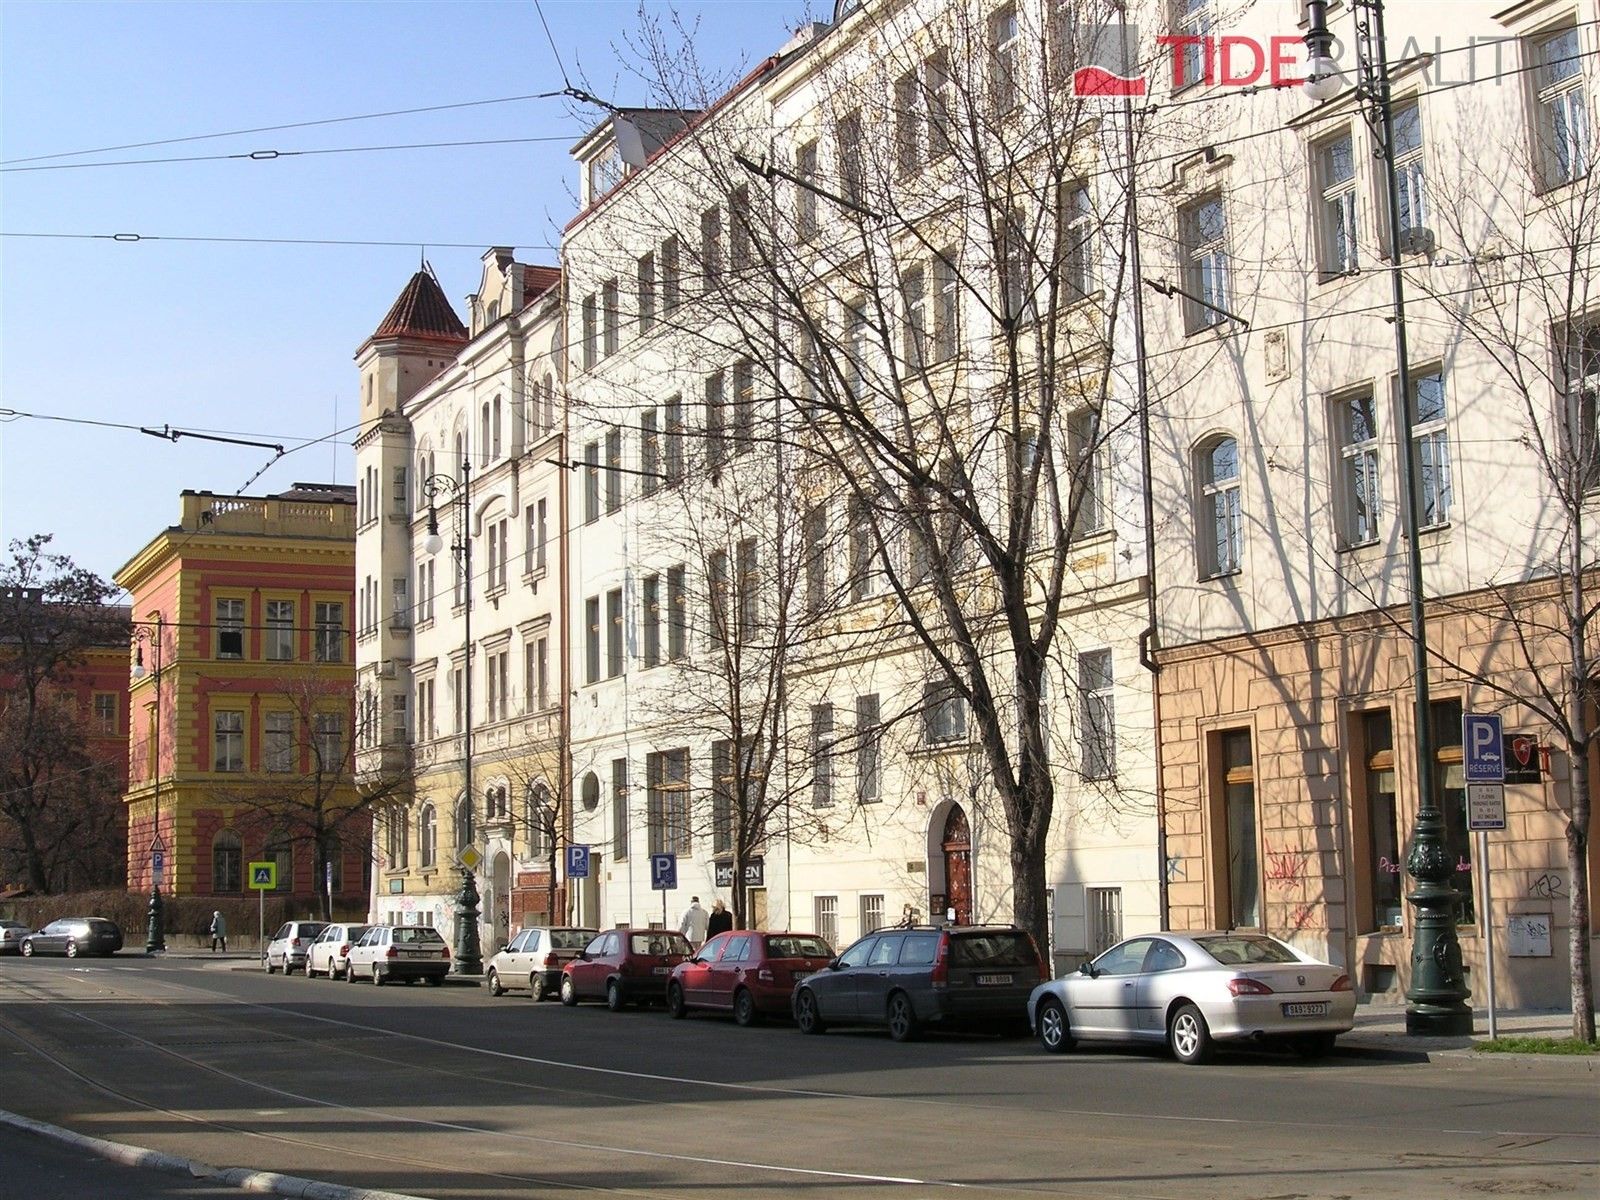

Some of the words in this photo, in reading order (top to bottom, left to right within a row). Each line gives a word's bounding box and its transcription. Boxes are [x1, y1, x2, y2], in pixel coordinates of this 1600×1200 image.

[1472, 722, 1494, 760] P
[572, 848, 584, 867] P
[655, 857, 671, 879] P
